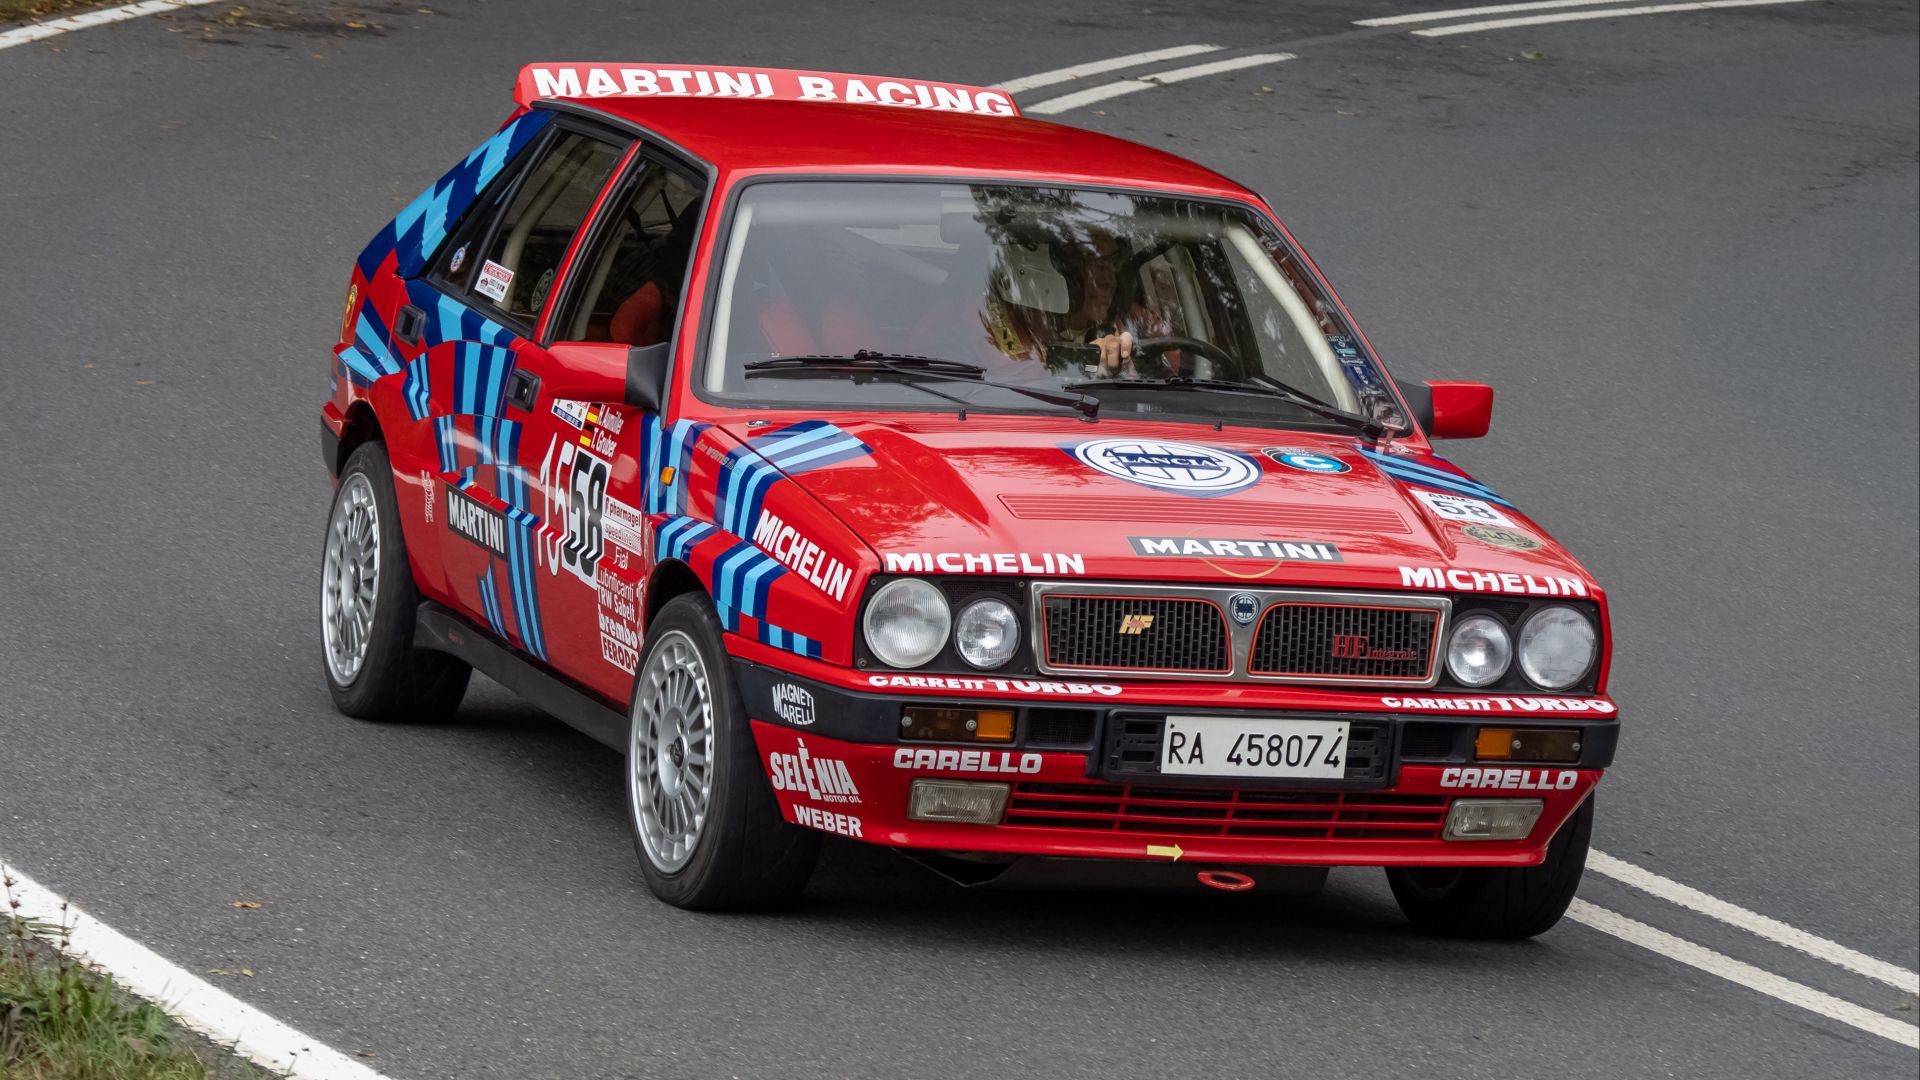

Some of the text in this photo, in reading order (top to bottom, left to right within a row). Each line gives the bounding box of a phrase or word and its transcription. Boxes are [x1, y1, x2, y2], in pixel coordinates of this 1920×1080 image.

[532, 67, 1014, 117] MARTINI RACING
[1120, 455, 1218, 467] LANCIA
[448, 490, 505, 554] MARTINI
[562, 450, 607, 577] 58
[609, 503, 641, 528] pharmagel
[1432, 500, 1498, 520] 58
[613, 546, 629, 570] Fiat
[752, 508, 852, 602] MICHELIN
[1138, 538, 1333, 560] MARTINI
[884, 552, 1086, 575] MICHELIN
[596, 562, 634, 602] Lubrificanti
[1398, 566, 1588, 597] MICHELIN
[597, 585, 635, 623] TRW Sabelt
[597, 603, 638, 650] brembo
[1118, 614, 1155, 635] HF
[602, 636, 638, 672] FERODO
[1332, 633, 1369, 659] HF
[772, 683, 815, 709] MAGNETI
[868, 675, 1123, 696] GARRETT TURBO
[774, 702, 815, 726] MARELLI
[1381, 697, 1615, 713] GARRETT TURBO
[893, 748, 1042, 774] CARELLO
[1168, 731, 1343, 769] RA 458074
[1440, 768, 1578, 790] CARELLO
[822, 794, 862, 804] MOTOR OIL
[793, 804, 863, 838] WEBER
